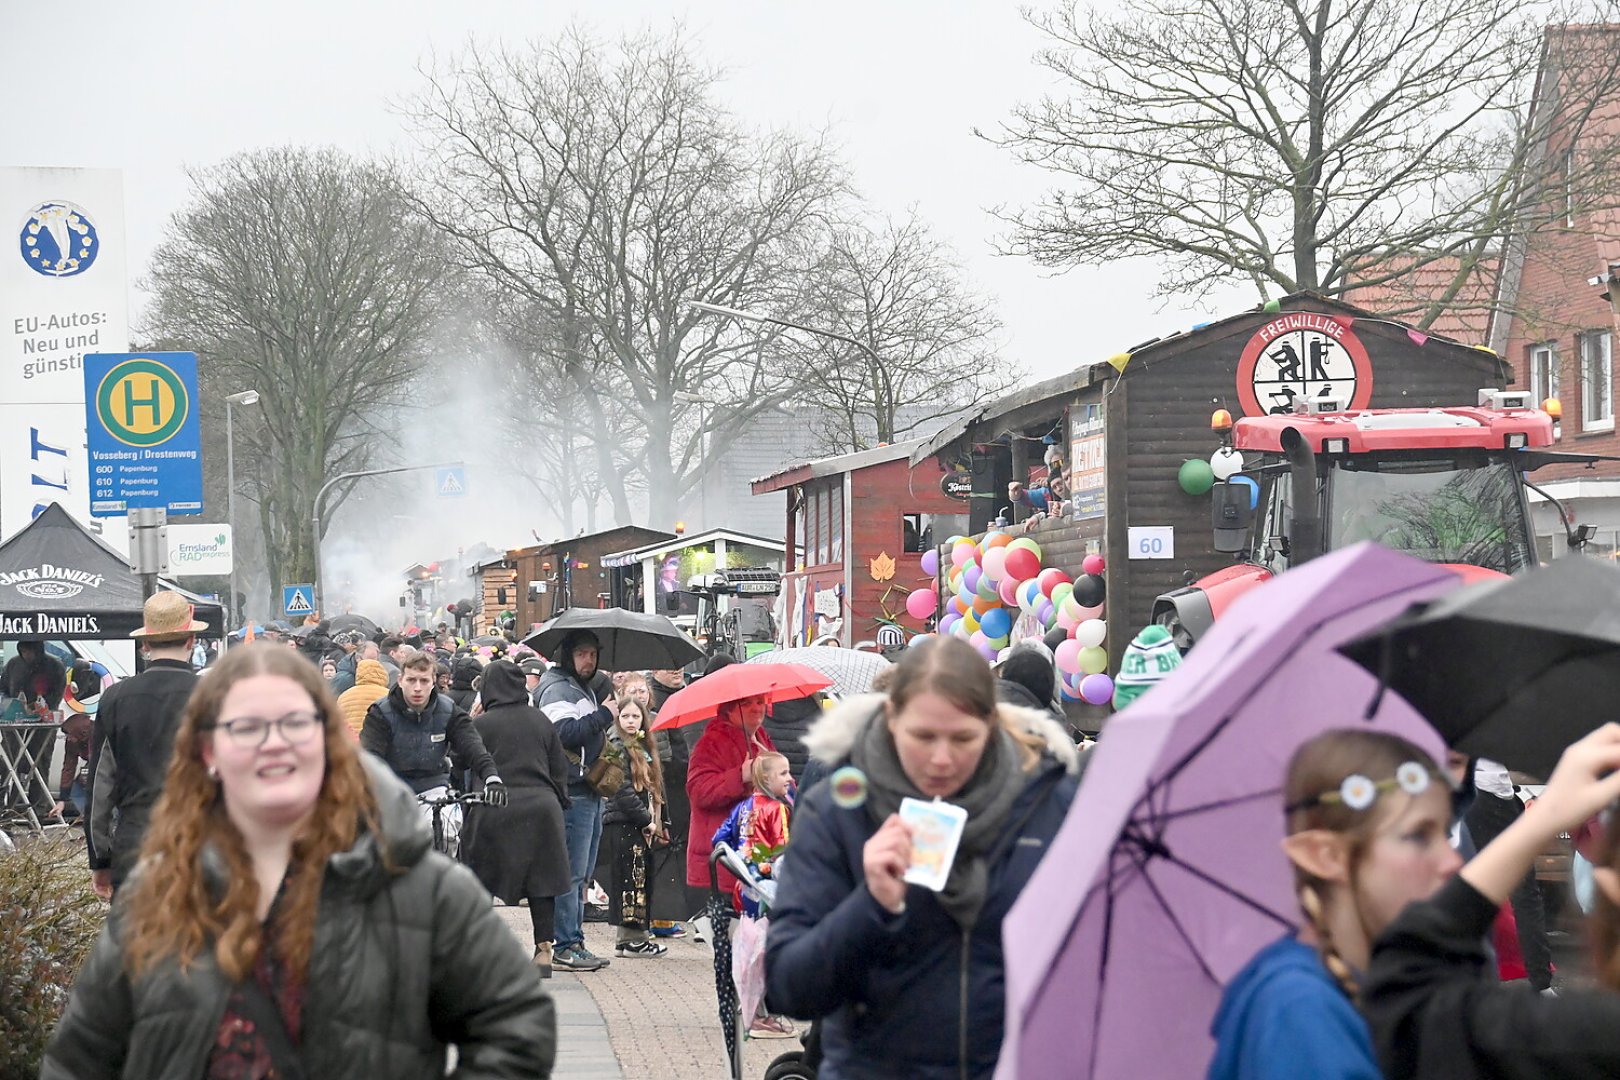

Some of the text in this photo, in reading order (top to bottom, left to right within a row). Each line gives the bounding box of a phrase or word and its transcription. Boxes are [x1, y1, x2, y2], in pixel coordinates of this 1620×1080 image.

[14, 311, 107, 335] EU-Autos:
[1260, 314, 1344, 342] FREIWILLIGE
[23, 328, 99, 355] Neu und
[23, 352, 82, 379] günsti
[124, 379, 161, 427] H
[93, 450, 138, 461] Vosseberg
[145, 449, 197, 460] Drostenweg
[96, 464, 158, 474] 600 Papenburg
[96, 477, 159, 486] 610 Papenburg
[96, 488, 160, 498] 612 Papenburg
[179, 543, 218, 552] Emsland
[1140, 537, 1162, 554] 60
[0, 563, 105, 588] JACK DANIEL'S
[0, 613, 34, 634] JACK
[1121, 652, 1147, 674] ER
